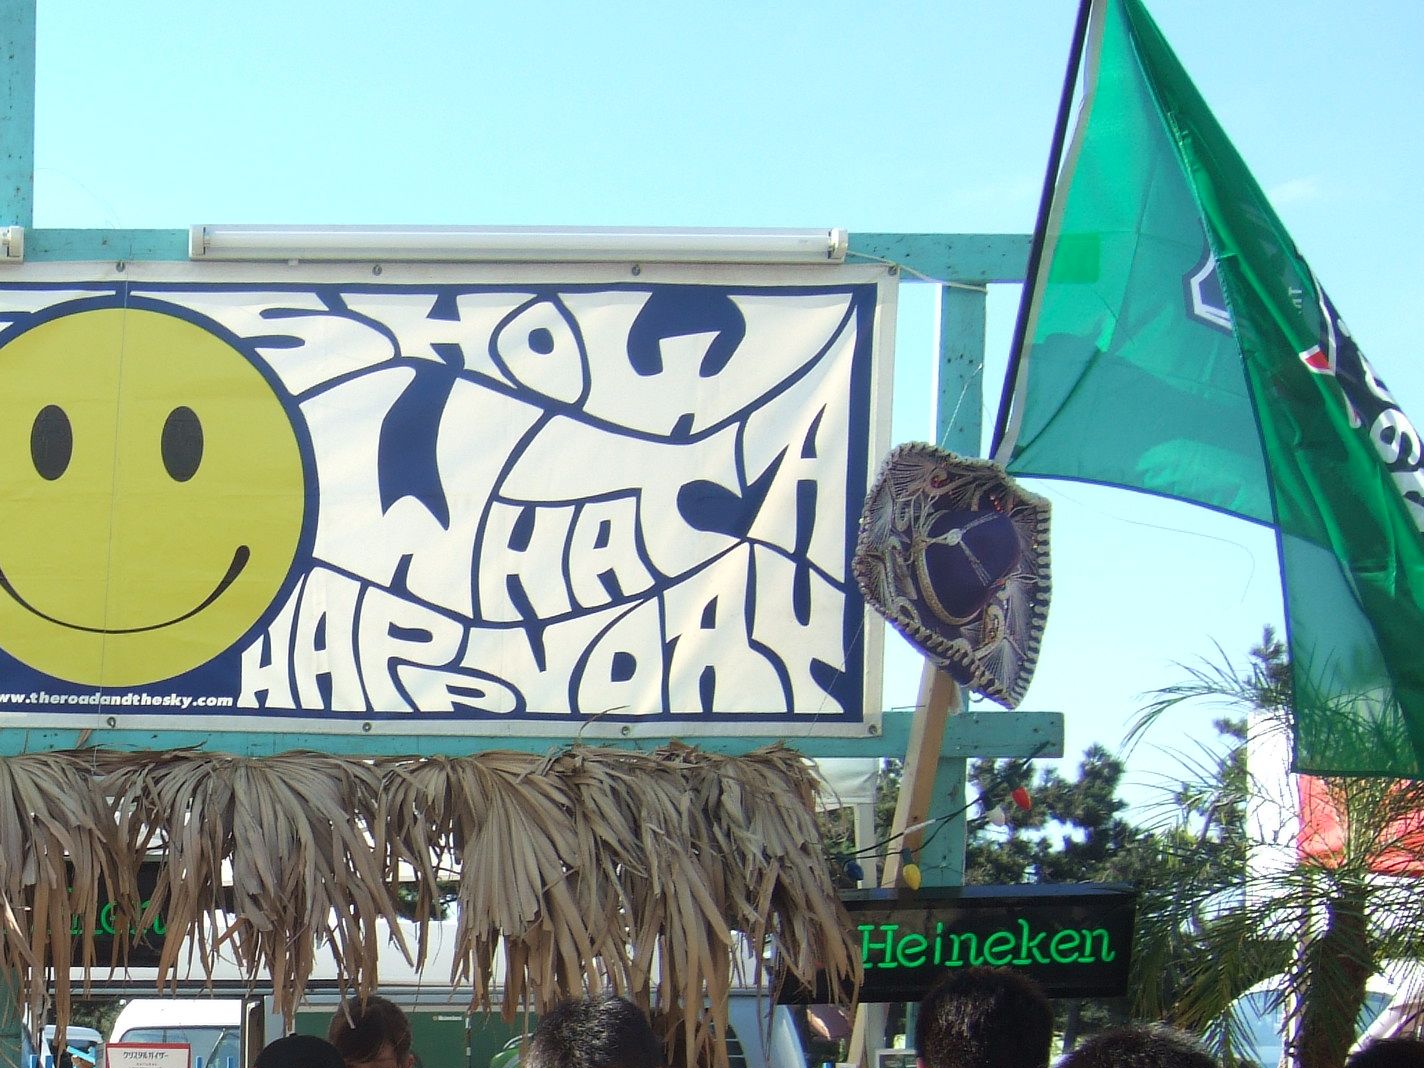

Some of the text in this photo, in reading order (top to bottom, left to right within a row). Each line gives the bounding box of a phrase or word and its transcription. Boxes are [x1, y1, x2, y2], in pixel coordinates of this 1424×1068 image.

[129, 291, 854, 436] SHOW
[297, 366, 746, 622] WHAT
[238, 568, 656, 713] HAPPY
[578, 540, 848, 714] DAY
[857, 919, 1115, 968] Heineken
